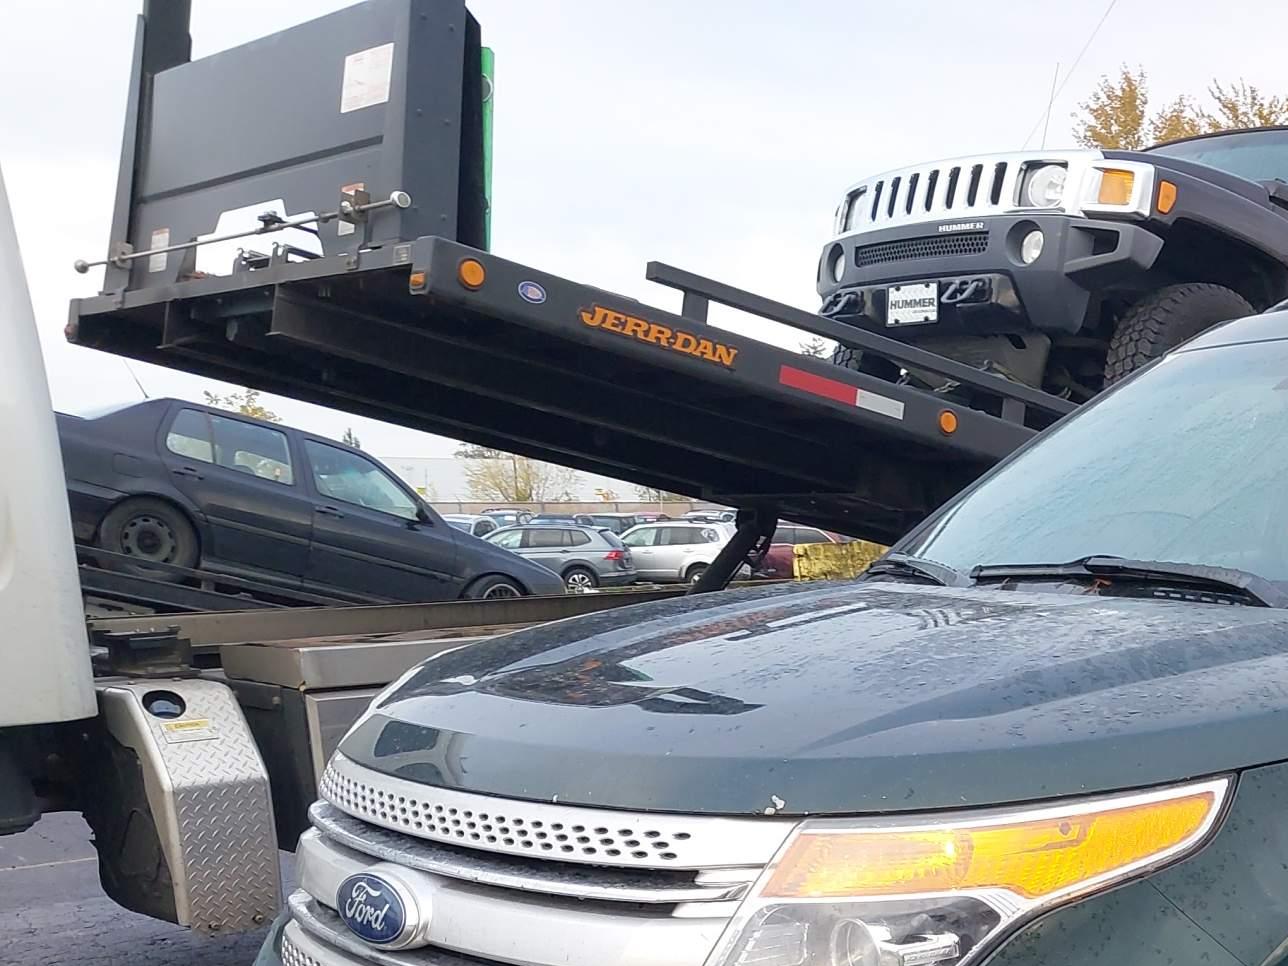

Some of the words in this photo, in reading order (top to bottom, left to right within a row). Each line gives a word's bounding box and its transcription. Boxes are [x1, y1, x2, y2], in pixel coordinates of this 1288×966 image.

[938, 222, 984, 232] HUMMER
[890, 298, 936, 310] HUMMER
[580, 305, 738, 366] JERR-DAN
[345, 881, 390, 930] Ford
